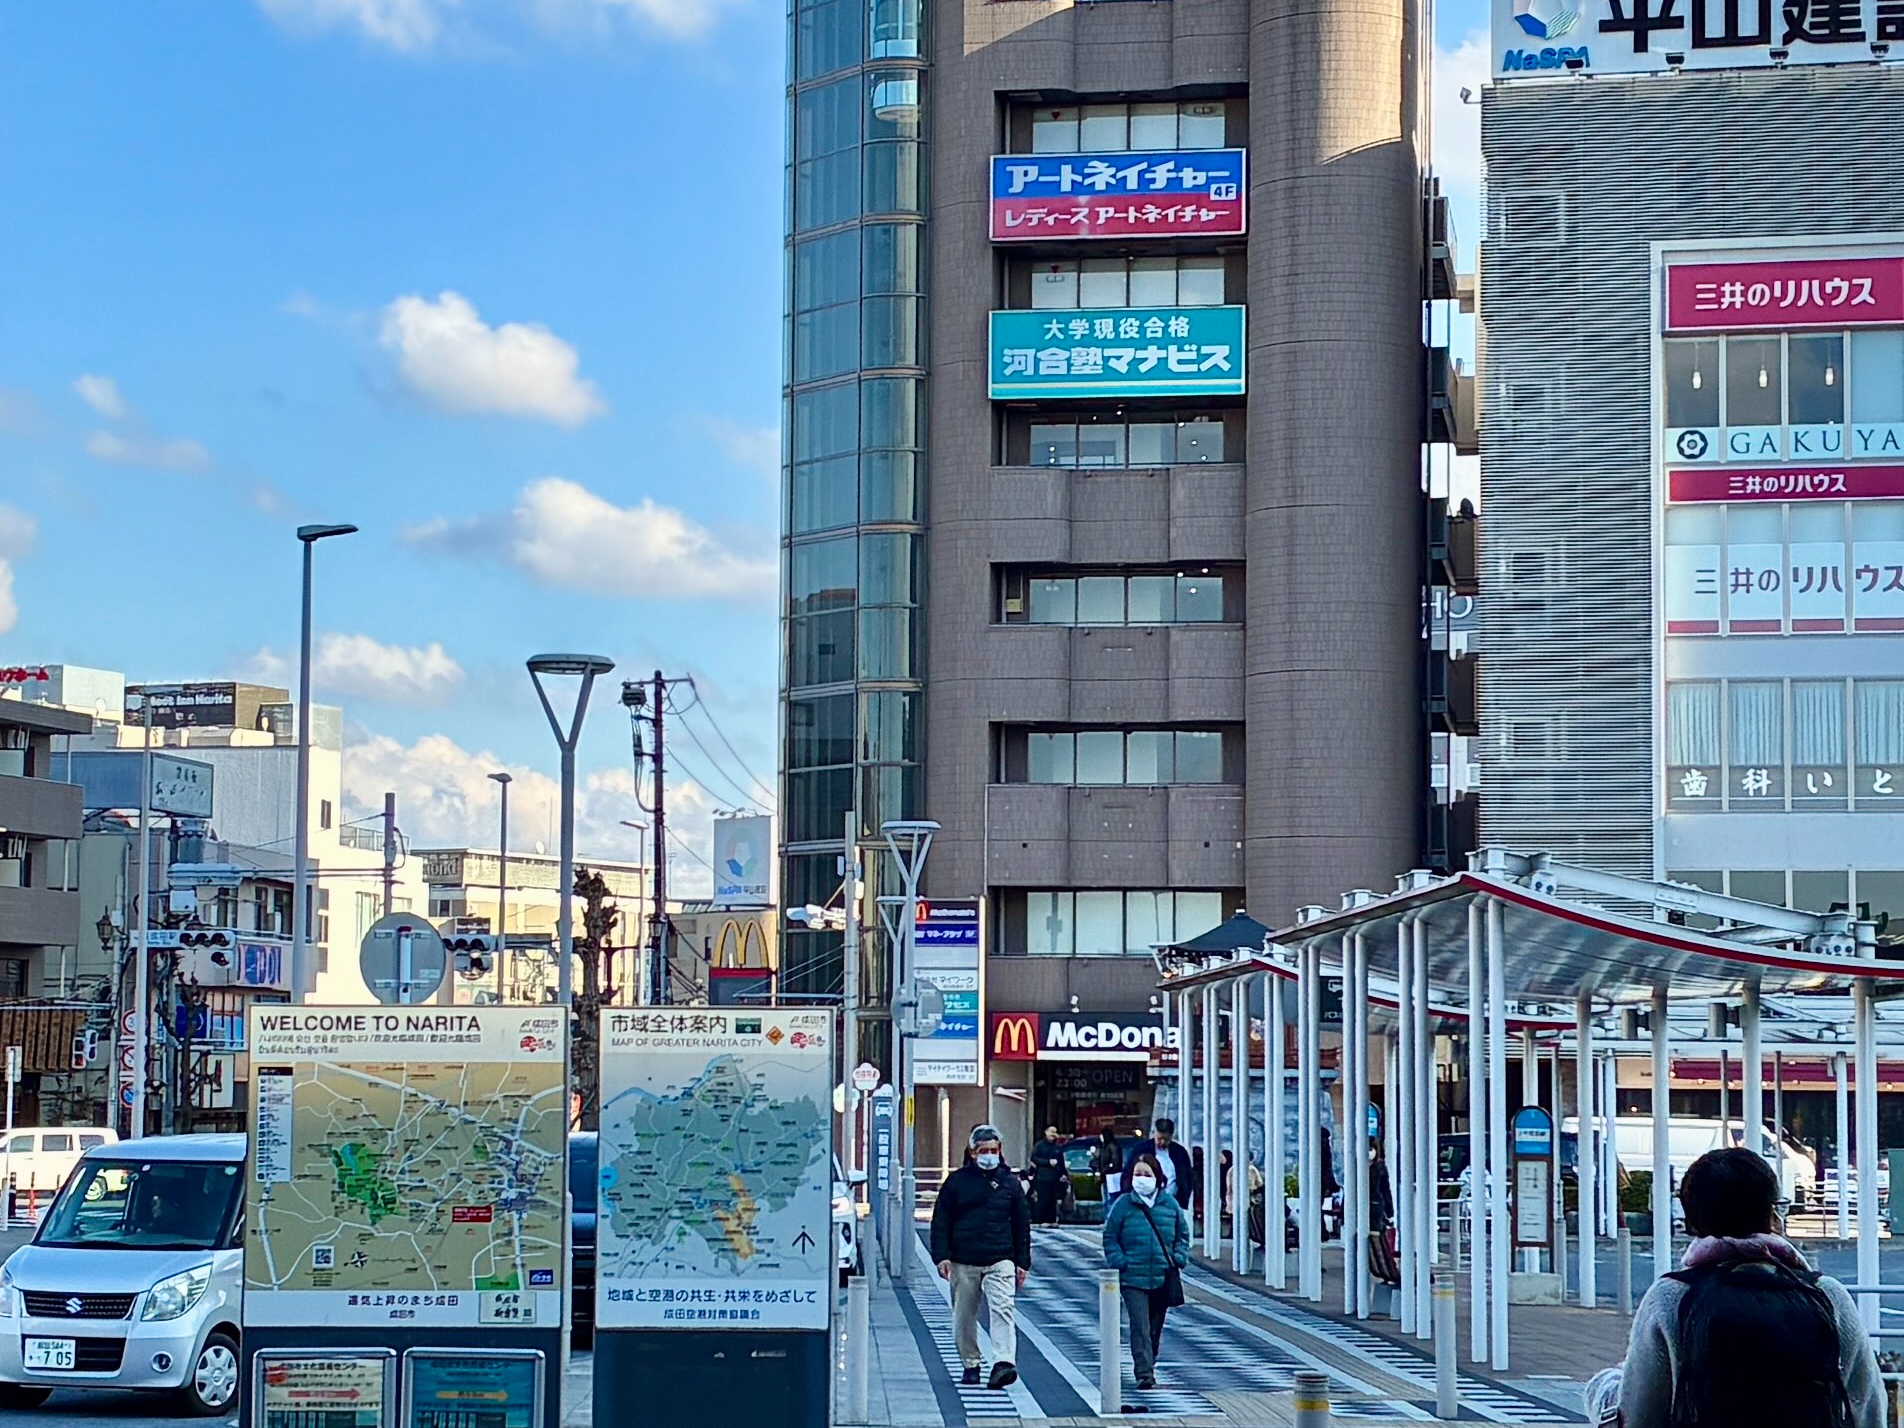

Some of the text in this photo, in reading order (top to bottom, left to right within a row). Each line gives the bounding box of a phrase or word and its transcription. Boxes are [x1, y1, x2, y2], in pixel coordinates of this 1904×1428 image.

[1005, 159, 1231, 193] アートネイチャー
[1212, 184, 1236, 199] 4F
[1004, 203, 1231, 228] レディース アートネイチャー
[1694, 277, 1876, 311] 三井のリハウス
[1042, 315, 1190, 341] 大学現役合格
[1001, 344, 1232, 377] 河合塾マナビス
[1729, 427, 1902, 456] GAKUYA
[1727, 472, 1847, 494] 三井のリハウス
[260, 1015, 481, 1032] WELCOME TO NARITA
[610, 1014, 728, 1034] 市域全体案内
[612, 1038, 763, 1047] MAP OF GREATER NARITA CITY
[1092, 1068, 1134, 1085] OPEN
[347, 1294, 459, 1307] 運気上昇のまち成田
[607, 1289, 817, 1303] 地域と空港の共生・共栄をめざして
[663, 1308, 761, 1320] 成田空港対策協議会
